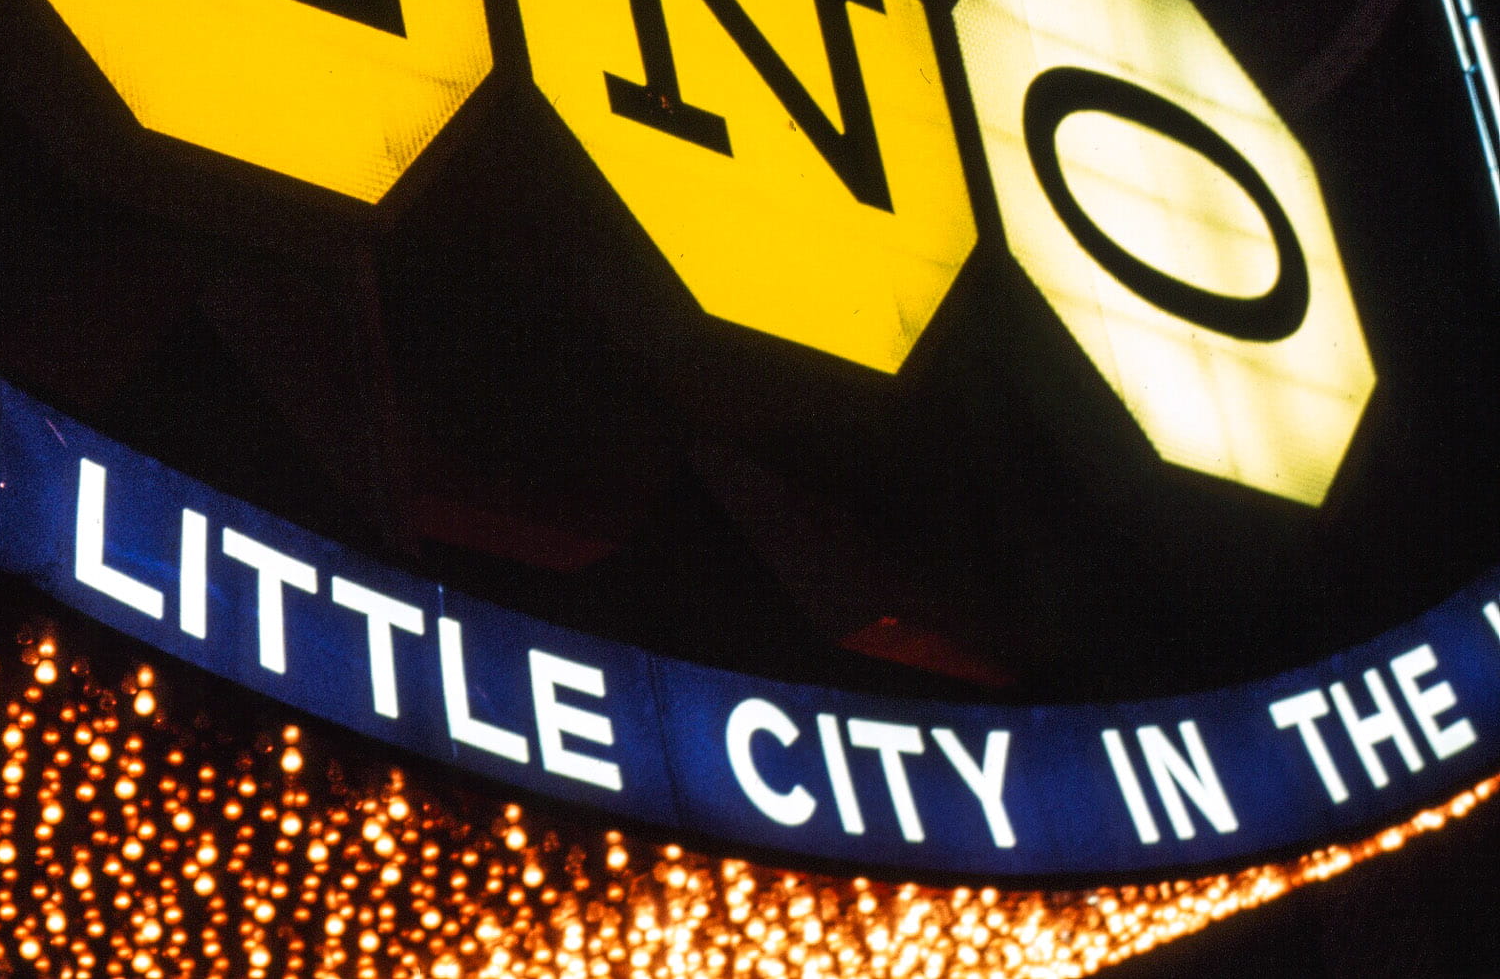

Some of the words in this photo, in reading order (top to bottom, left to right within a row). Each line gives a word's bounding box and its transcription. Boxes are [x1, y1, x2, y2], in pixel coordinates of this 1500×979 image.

[75, 457, 623, 791] LITTLE
[726, 698, 1016, 848] CITY
[1102, 720, 1239, 844] IN
[1269, 644, 1476, 803] THE
